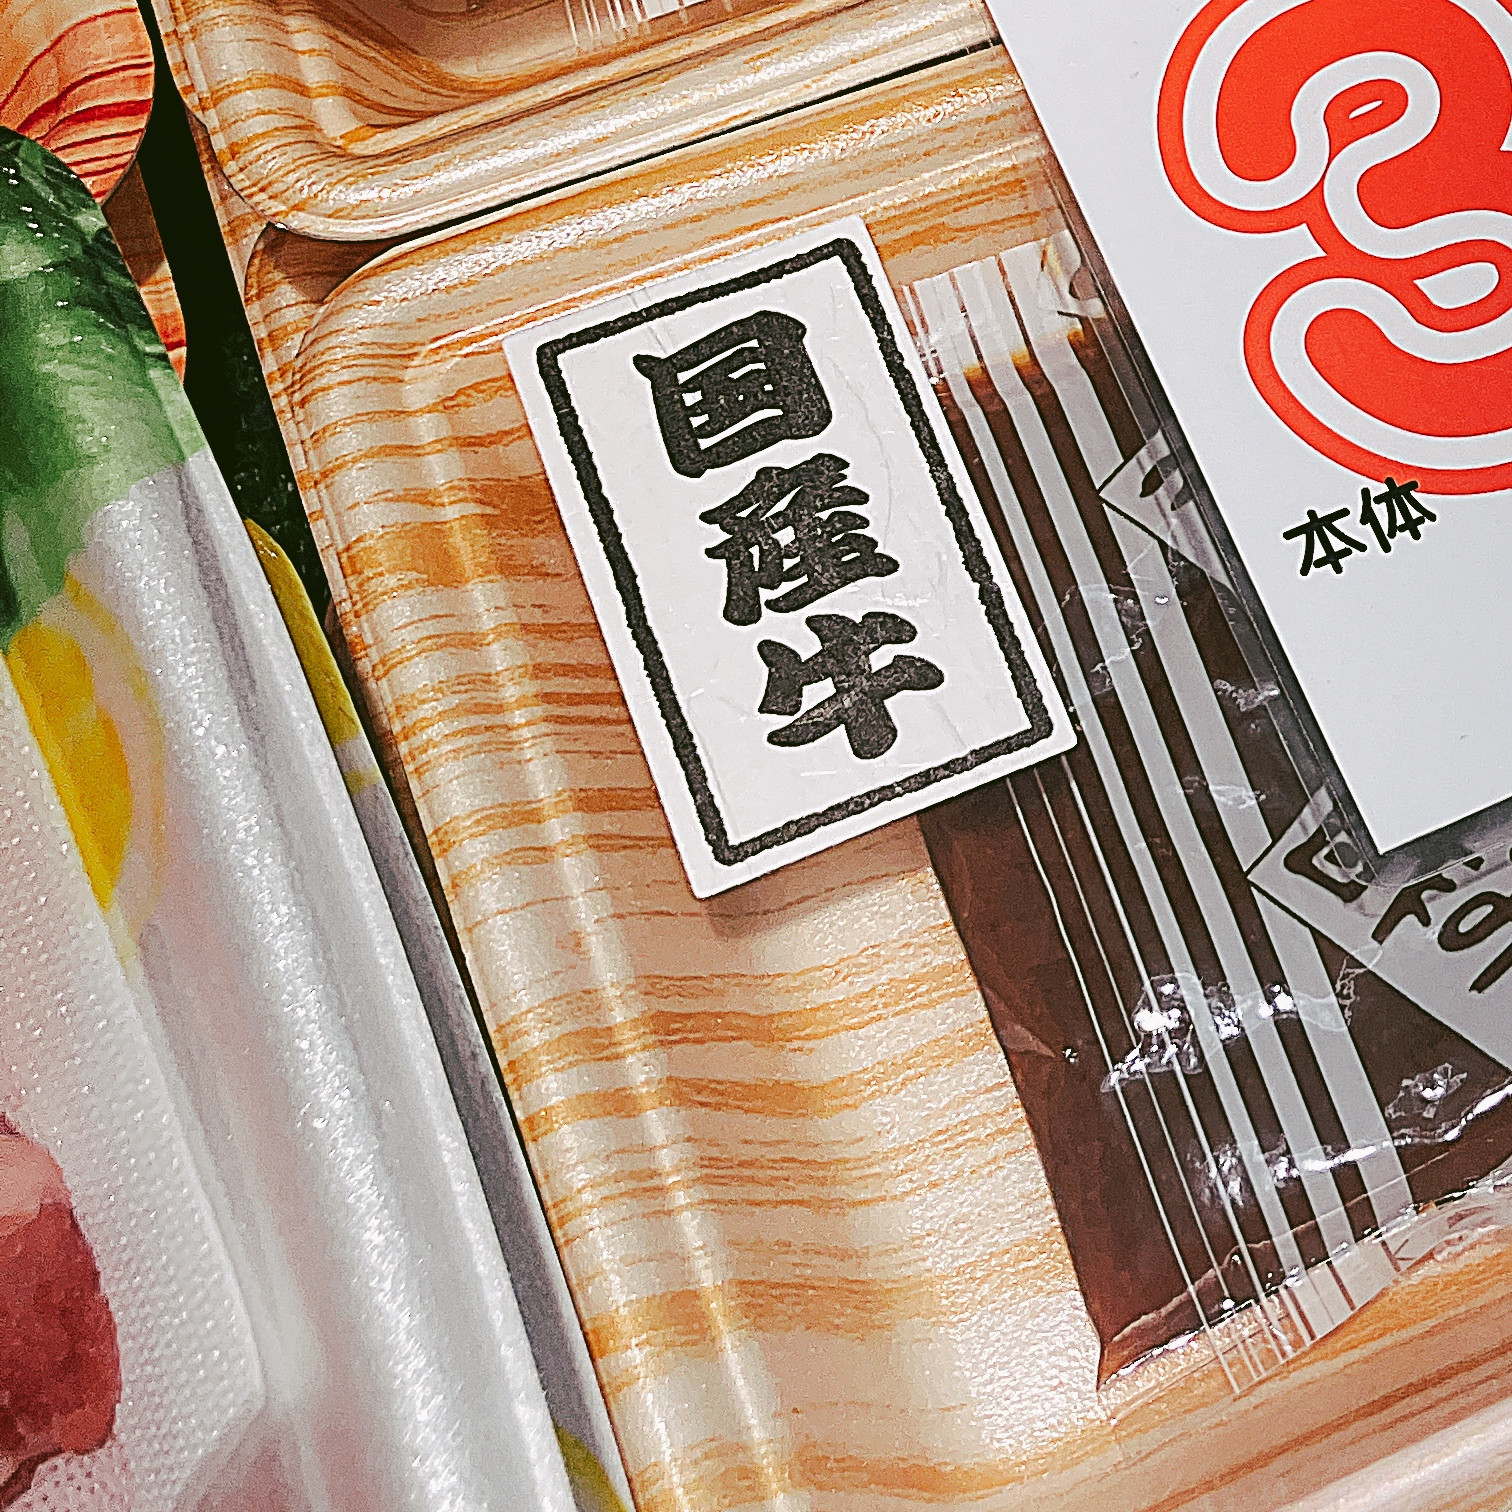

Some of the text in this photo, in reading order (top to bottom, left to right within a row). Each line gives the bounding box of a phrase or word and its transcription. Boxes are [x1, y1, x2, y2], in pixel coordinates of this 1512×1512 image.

[633, 309, 944, 759] 国産牛
[1283, 477, 1436, 576] 本体
